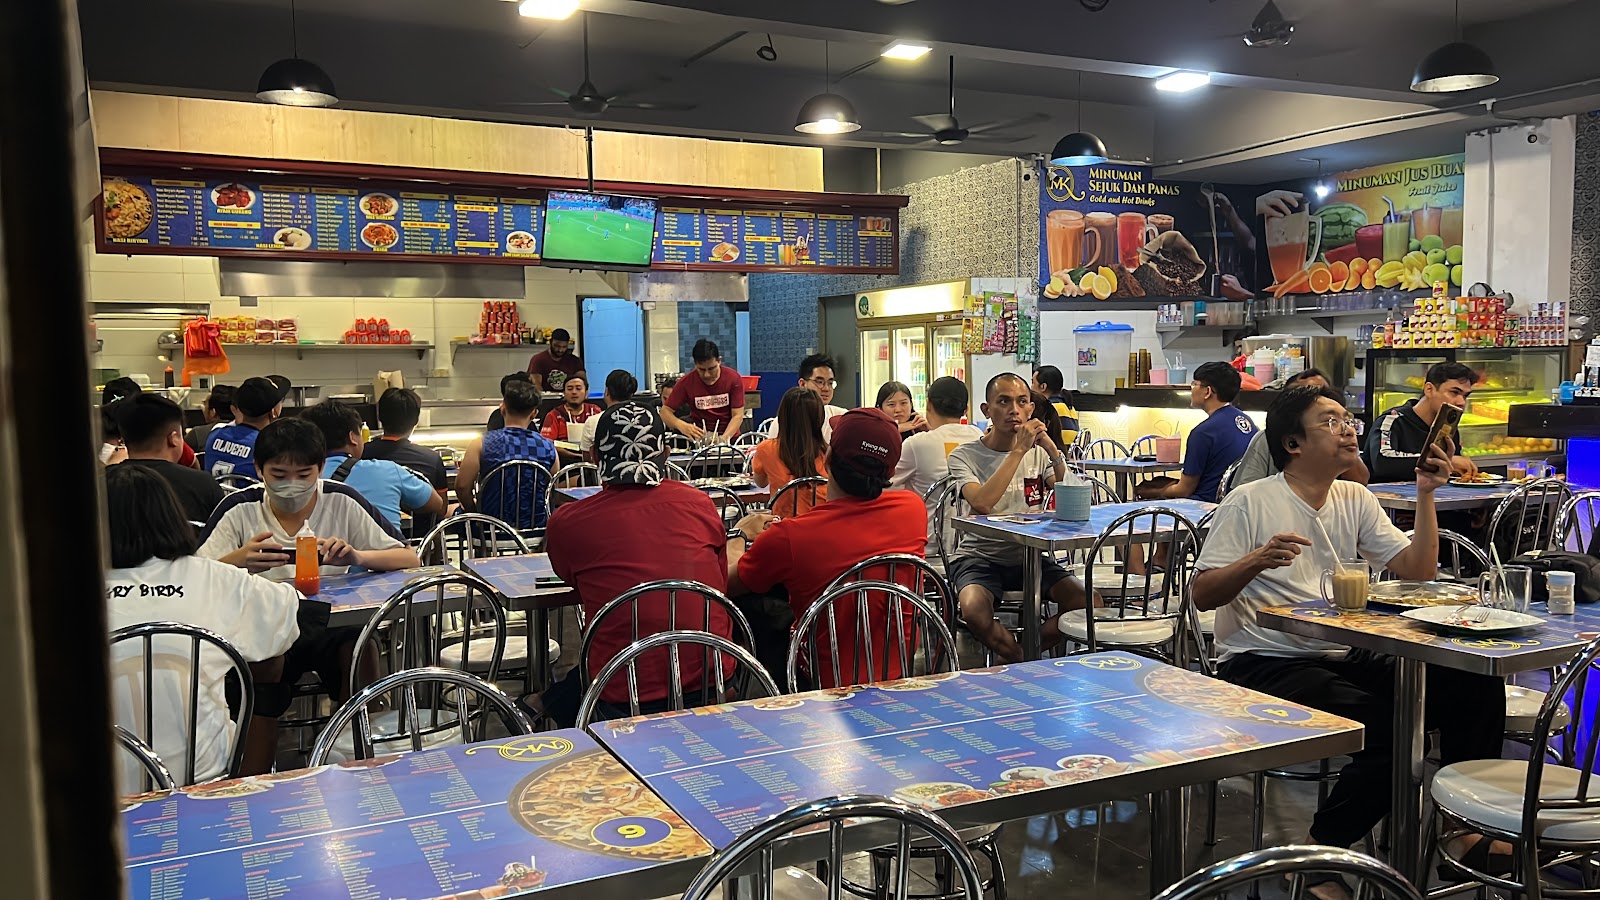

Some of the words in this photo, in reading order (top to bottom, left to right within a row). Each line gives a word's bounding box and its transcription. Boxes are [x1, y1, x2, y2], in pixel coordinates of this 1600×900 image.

[1089, 168, 1142, 181] MINUMAN
[1336, 171, 1402, 193] MINUMAN
[1404, 167, 1429, 186] JUS
[1088, 179, 1121, 194] SEJUK
[1123, 182, 1147, 194] DAN
[1148, 183, 1180, 196] PANAS
[1408, 185, 1431, 197] Fruit
[1432, 182, 1458, 195] Juice
[1089, 195, 1107, 204] Cold
[1108, 196, 1121, 204] and
[1122, 196, 1134, 205] Hot
[1135, 197, 1156, 207] Drinks
[212, 438, 251, 459] OLIVERO
[861, 440, 879, 451] Kyung
[878, 445, 889, 454] Hee
[139, 583, 184, 598] BIRDS
